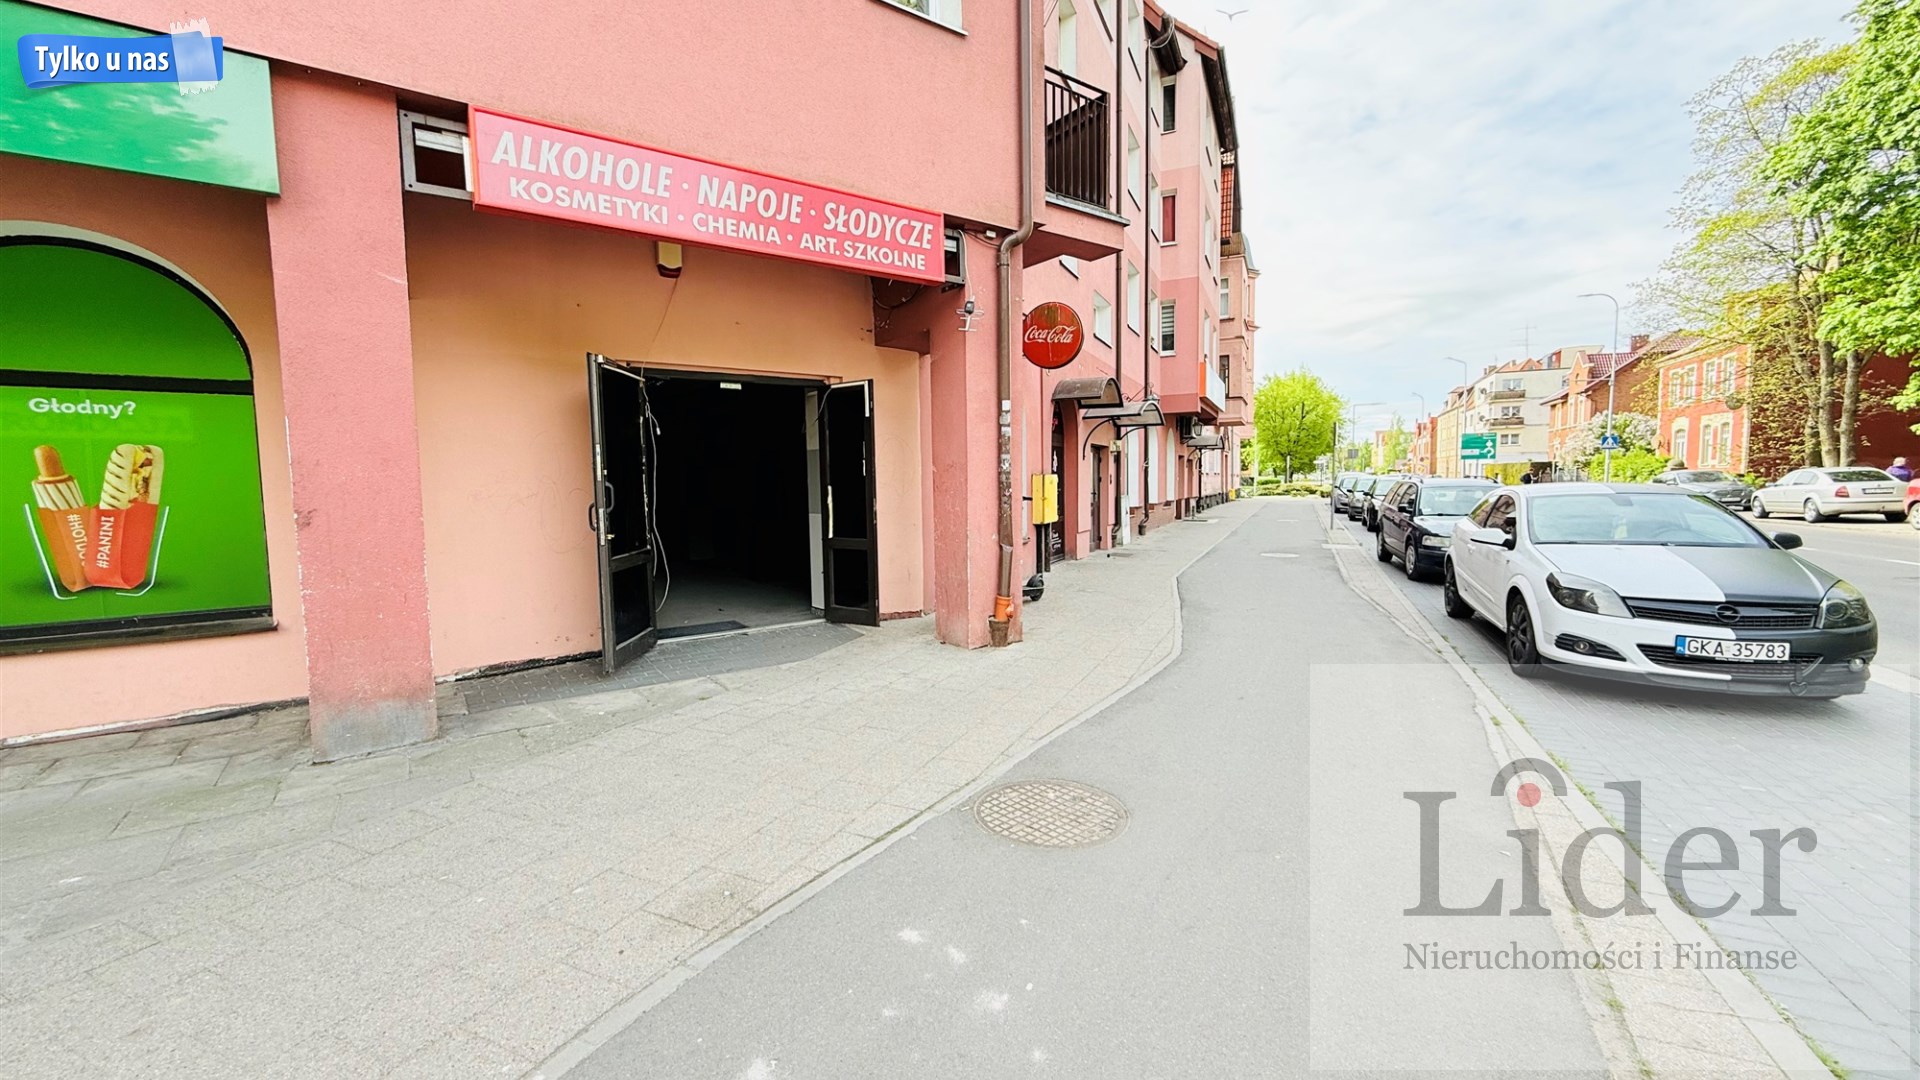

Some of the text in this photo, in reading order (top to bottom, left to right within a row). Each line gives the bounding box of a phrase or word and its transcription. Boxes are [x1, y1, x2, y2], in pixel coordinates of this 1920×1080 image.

[491, 131, 934, 250] ALKOHOLE NAPOJE SŁODYCZE
[509, 177, 926, 270] KOSMETYKI CHEMIA ART. SZKOLNE
[28, 397, 137, 419] Głodny?
[95, 515, 115, 569] #PANINI
[1686, 639, 1725, 656] GKA
[1732, 642, 1787, 659] 35783
